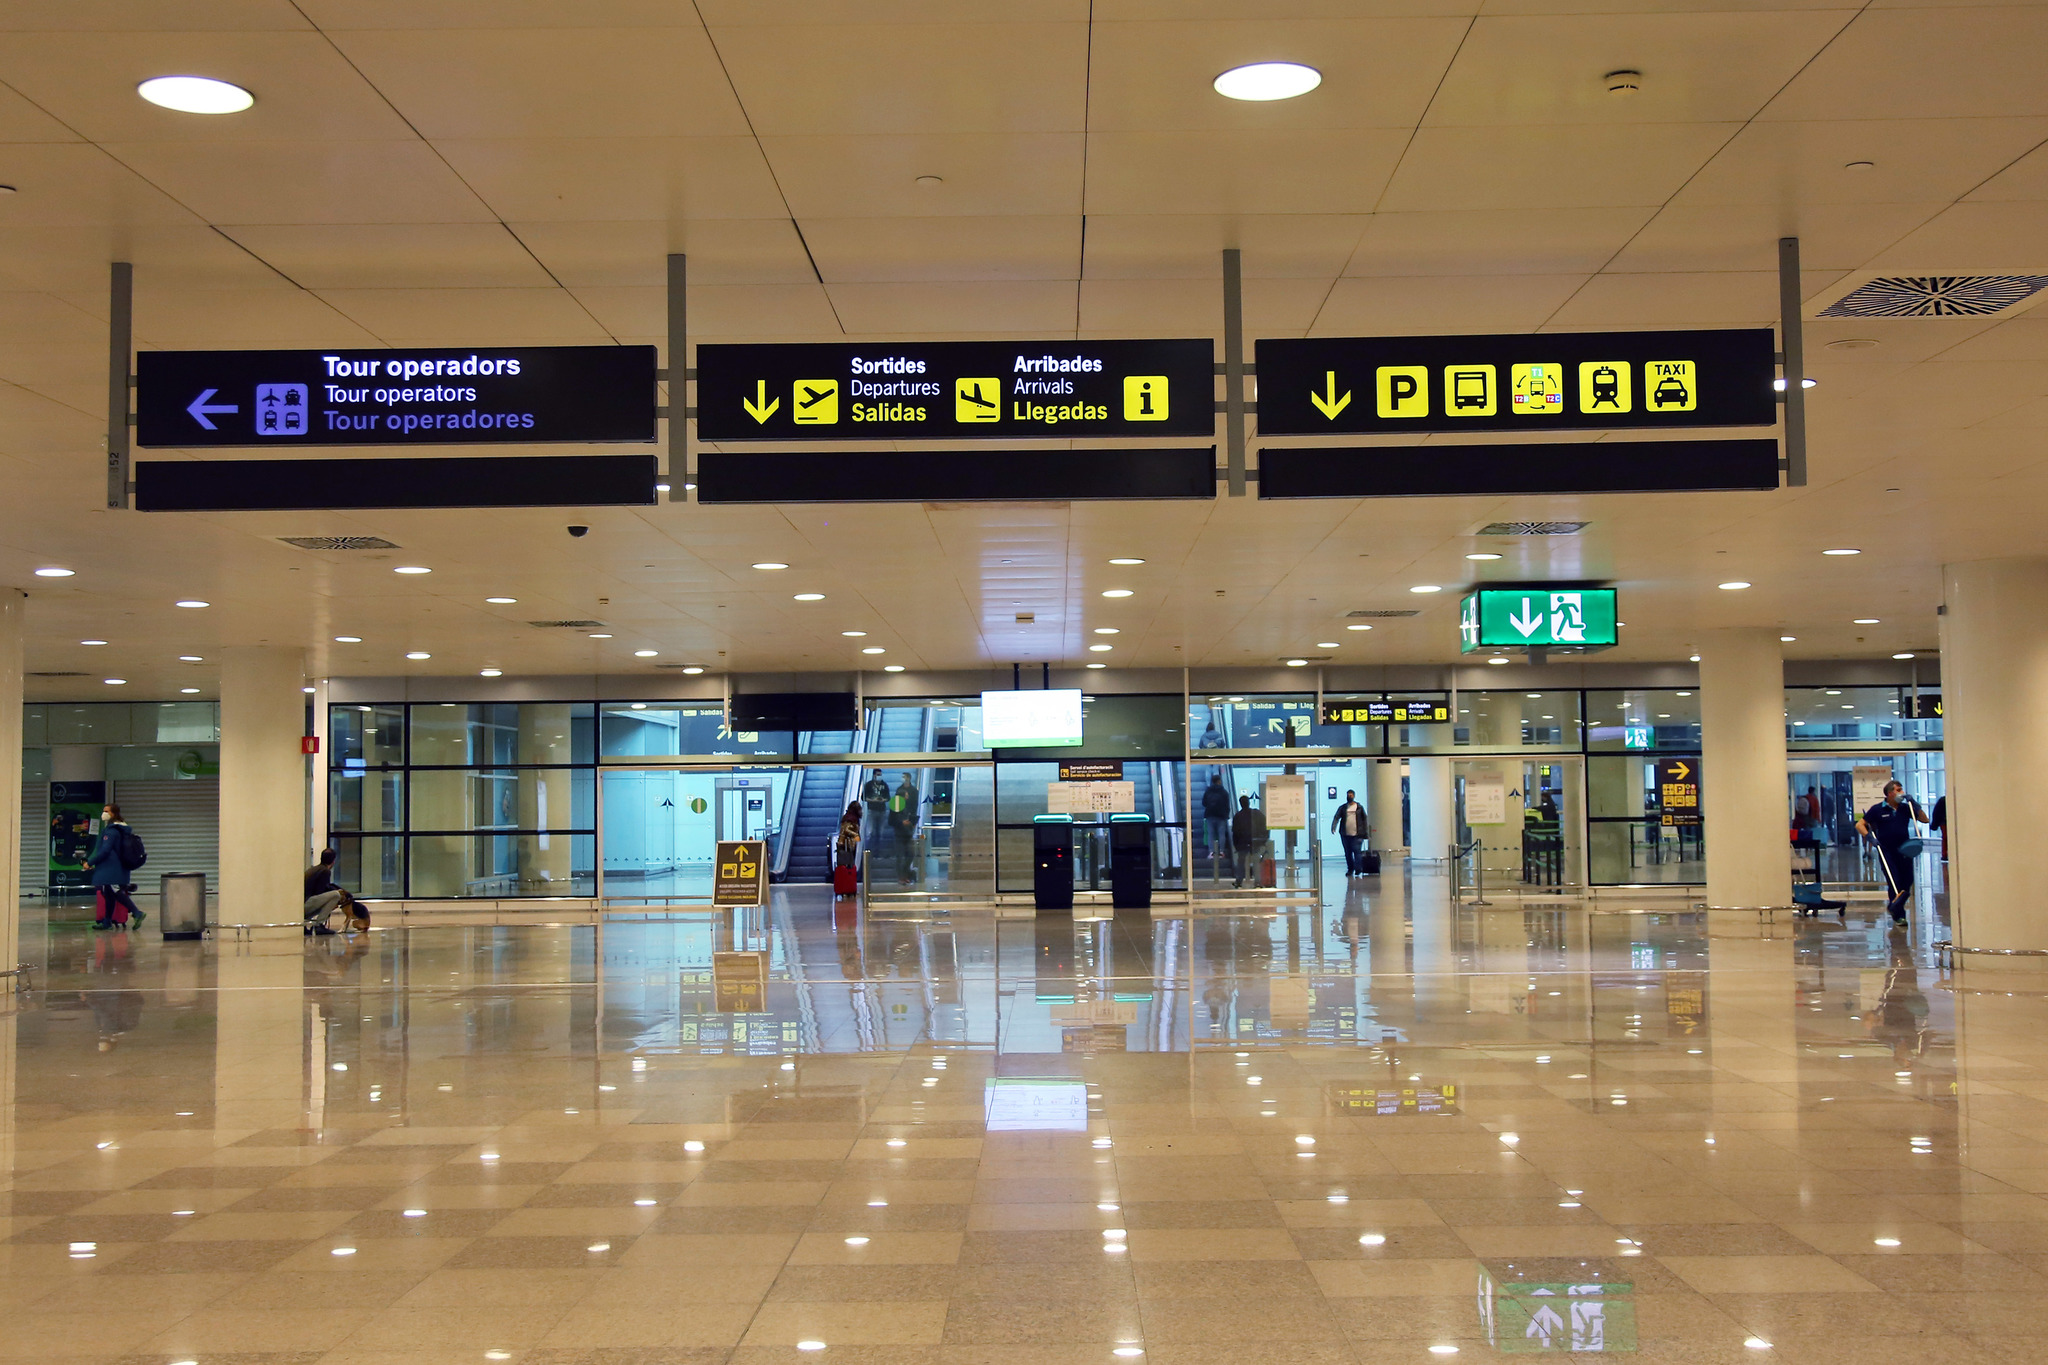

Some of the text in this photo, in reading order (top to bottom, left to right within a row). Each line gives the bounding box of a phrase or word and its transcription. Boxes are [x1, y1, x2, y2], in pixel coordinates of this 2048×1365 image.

[322, 354, 522, 381] Tour operadors
[851, 356, 927, 375] Sortides
[1013, 354, 1103, 373] Arribades
[1531, 368, 1543, 377] T1
[1655, 363, 1686, 376] TAXI
[323, 384, 477, 407] Tour operators
[851, 379, 941, 399] Departures
[1013, 377, 1074, 395] Arrivals
[1391, 375, 1418, 411] P
[323, 409, 535, 435] Tour operadores
[851, 402, 927, 422] Salidas
[1013, 400, 1108, 424] Llegadas
